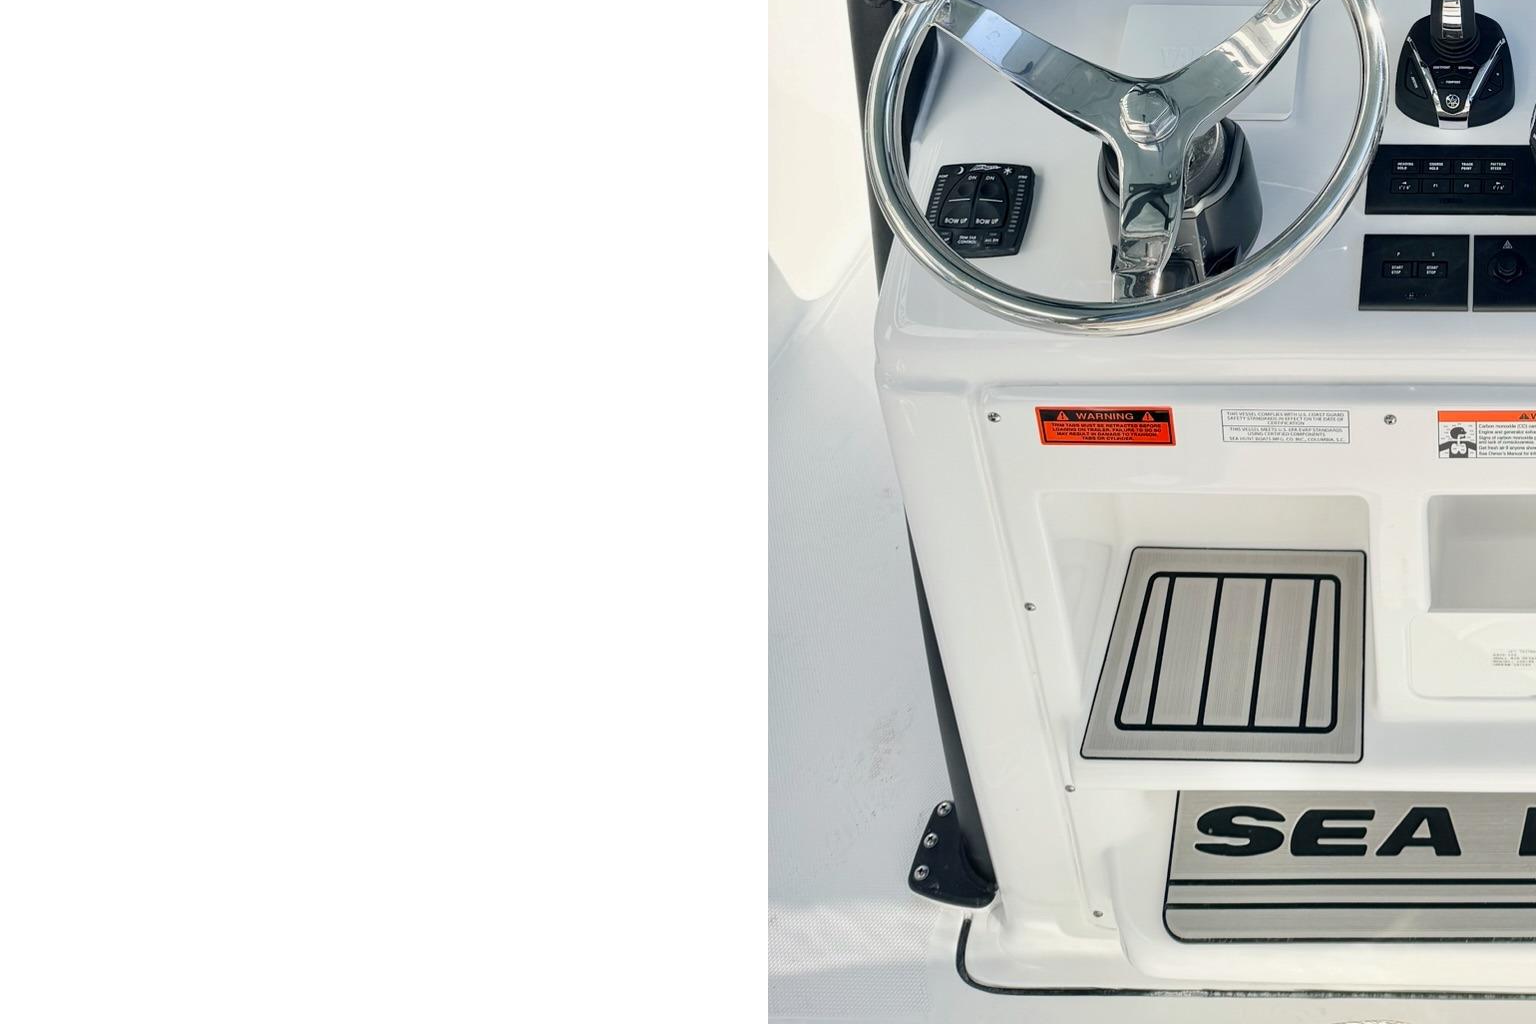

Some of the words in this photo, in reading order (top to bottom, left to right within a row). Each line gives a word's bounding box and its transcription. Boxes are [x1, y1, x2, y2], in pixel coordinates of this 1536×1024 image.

[960, 217, 968, 225] UP
[991, 218, 999, 226] UP
[1075, 412, 1135, 420] WARNING
[1193, 805, 1463, 858] SEA
